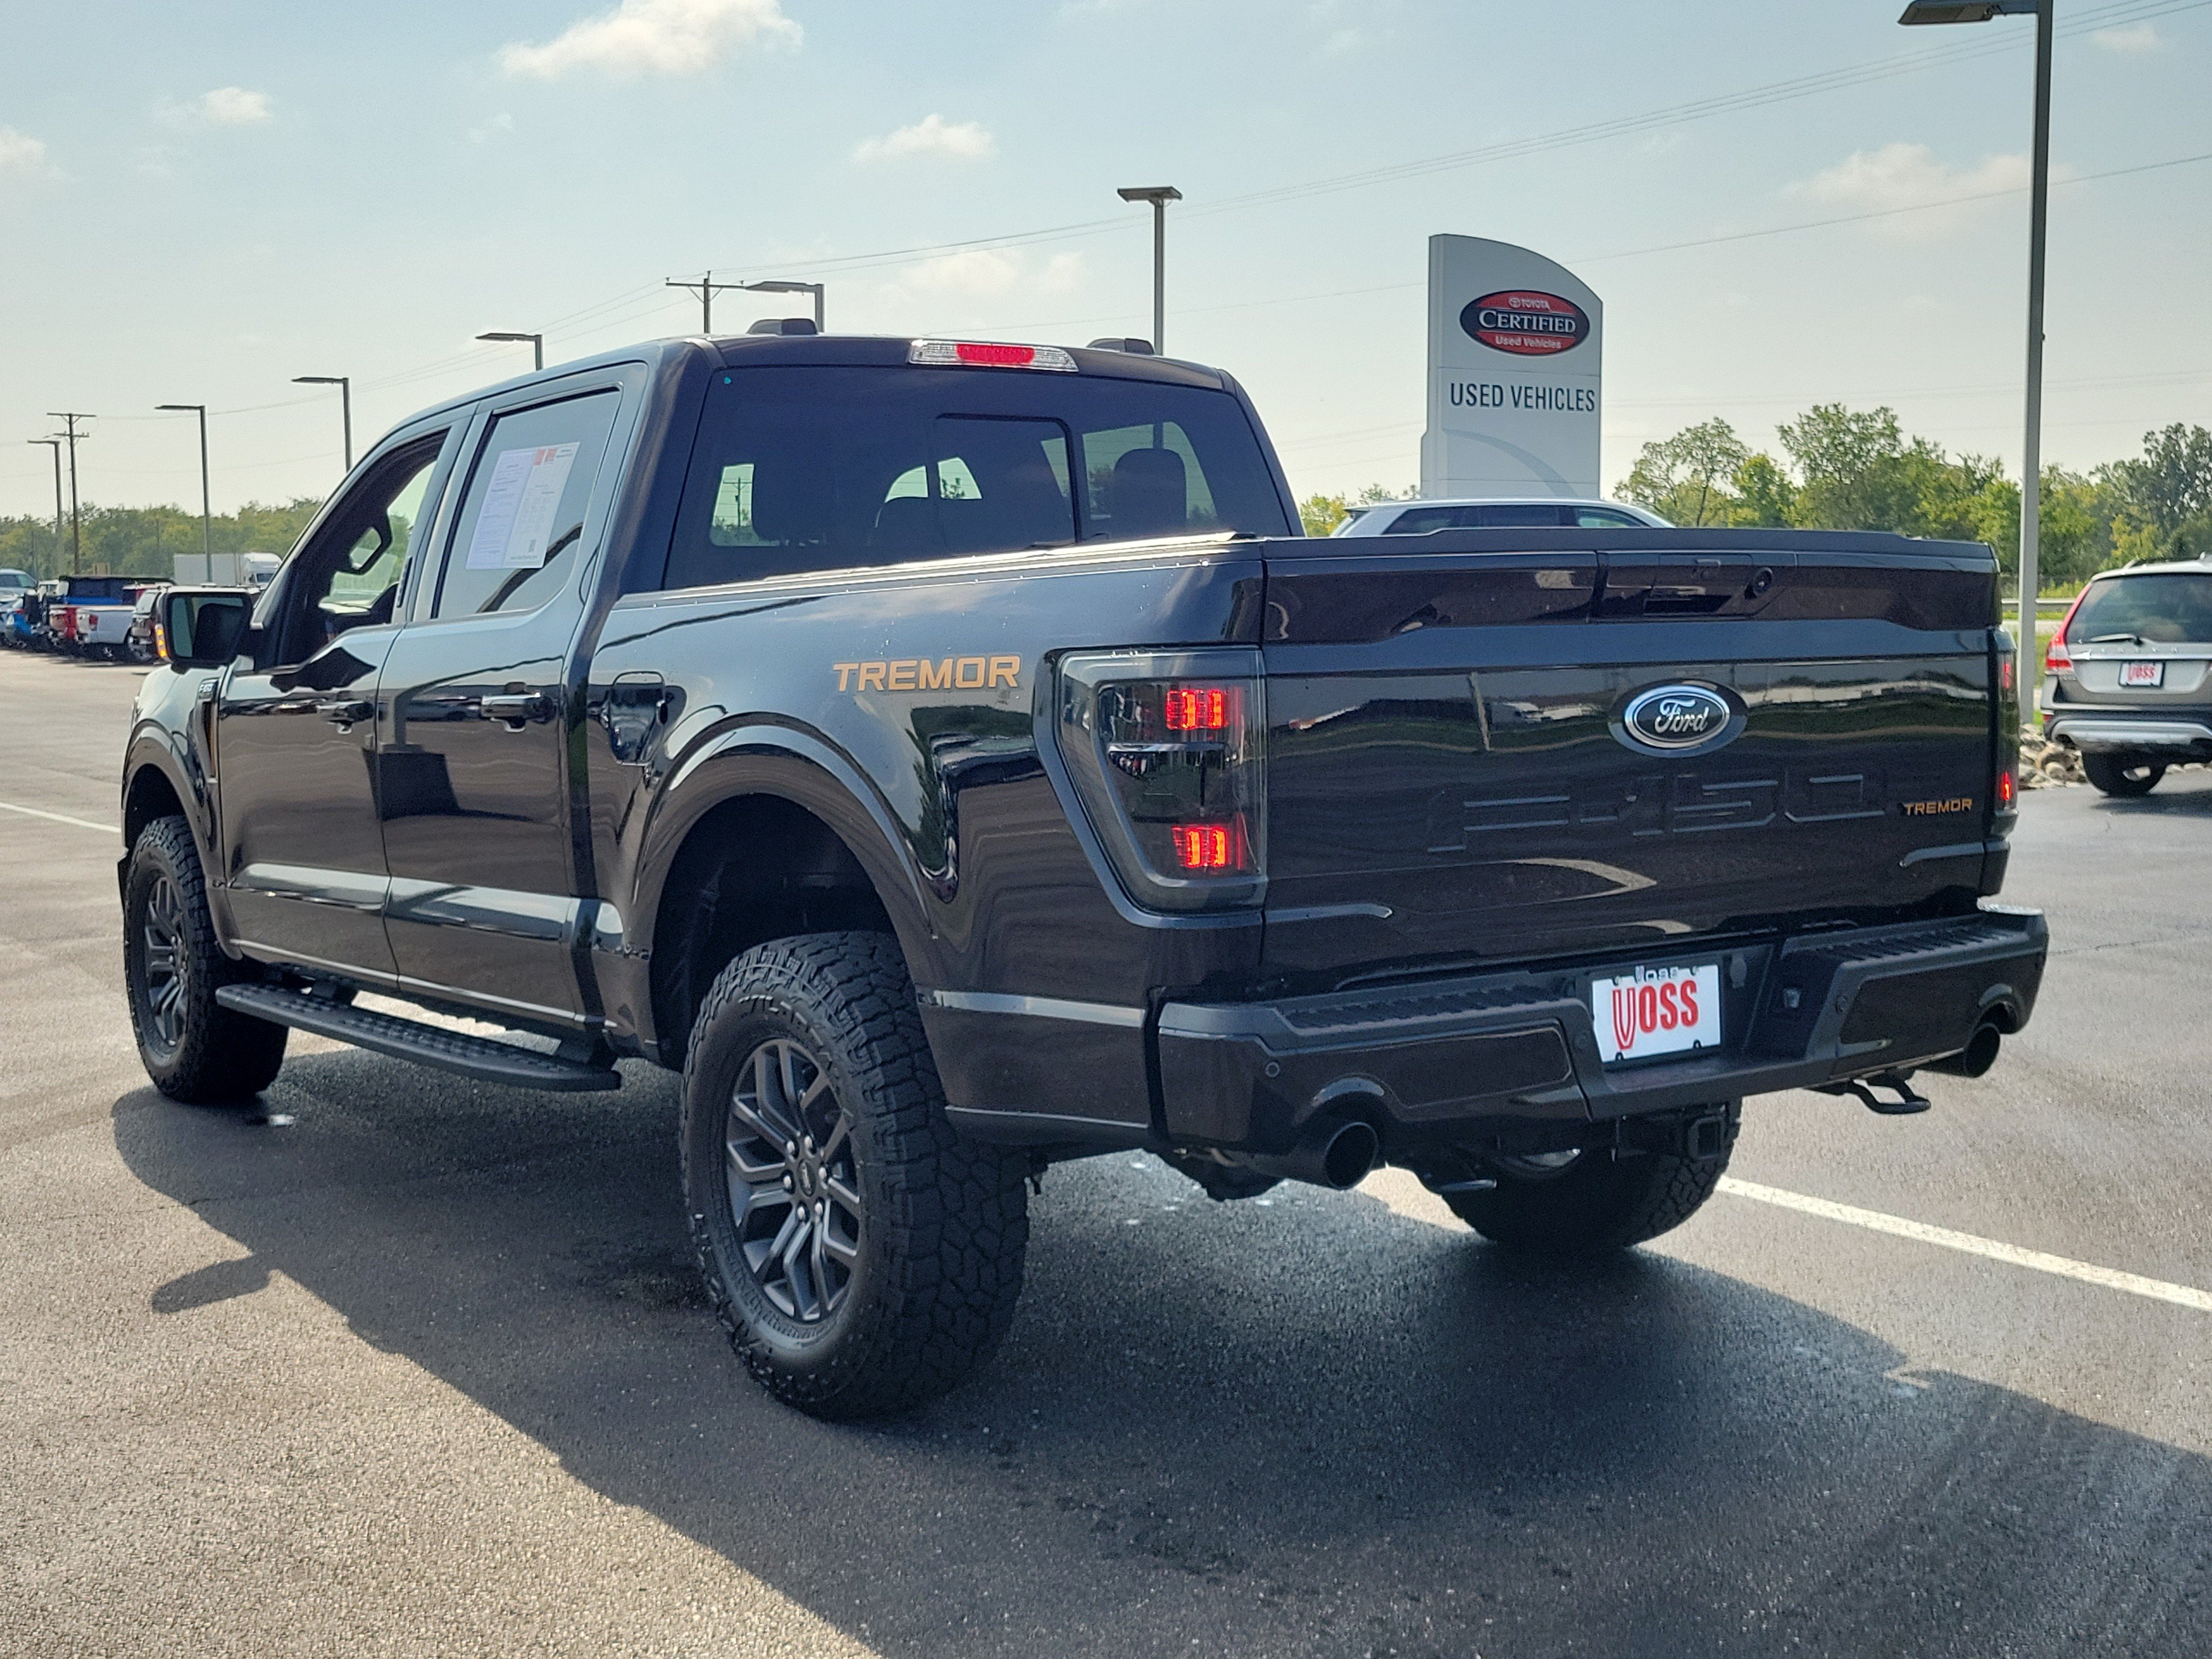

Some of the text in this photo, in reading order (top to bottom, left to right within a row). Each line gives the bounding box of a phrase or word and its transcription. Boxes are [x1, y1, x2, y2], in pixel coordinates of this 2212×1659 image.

[1521, 298, 1551, 310] TOYOTA
[1479, 310, 1576, 332] CERTIFIED
[1495, 335, 1561, 348] Used Vehicles
[1450, 383, 1595, 413] USED VEHICLES
[833, 656, 1021, 692] TREMOR
[1654, 699, 1709, 734] Ford
[1904, 798, 1973, 816] TREMOR
[1612, 980, 1699, 1050] VOSS
